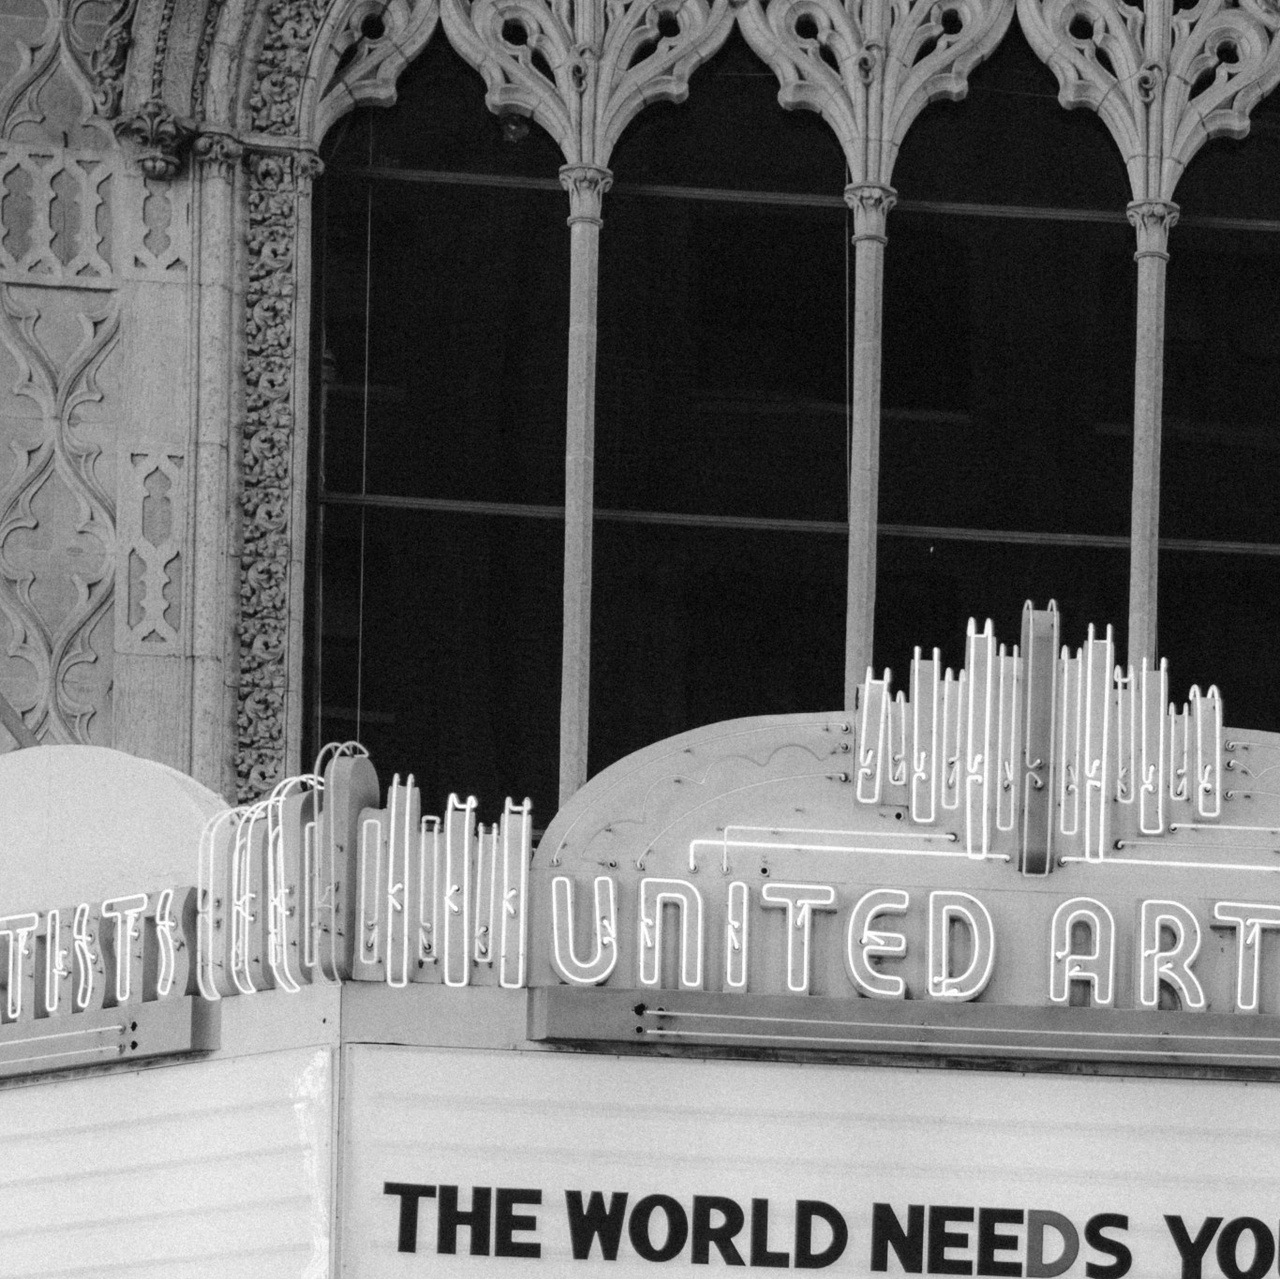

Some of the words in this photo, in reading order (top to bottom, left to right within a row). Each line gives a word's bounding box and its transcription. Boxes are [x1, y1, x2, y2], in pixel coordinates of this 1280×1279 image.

[549, 876, 996, 1001] UNITED
[383, 1181, 543, 1258] THE
[565, 1189, 849, 1270] WORLD
